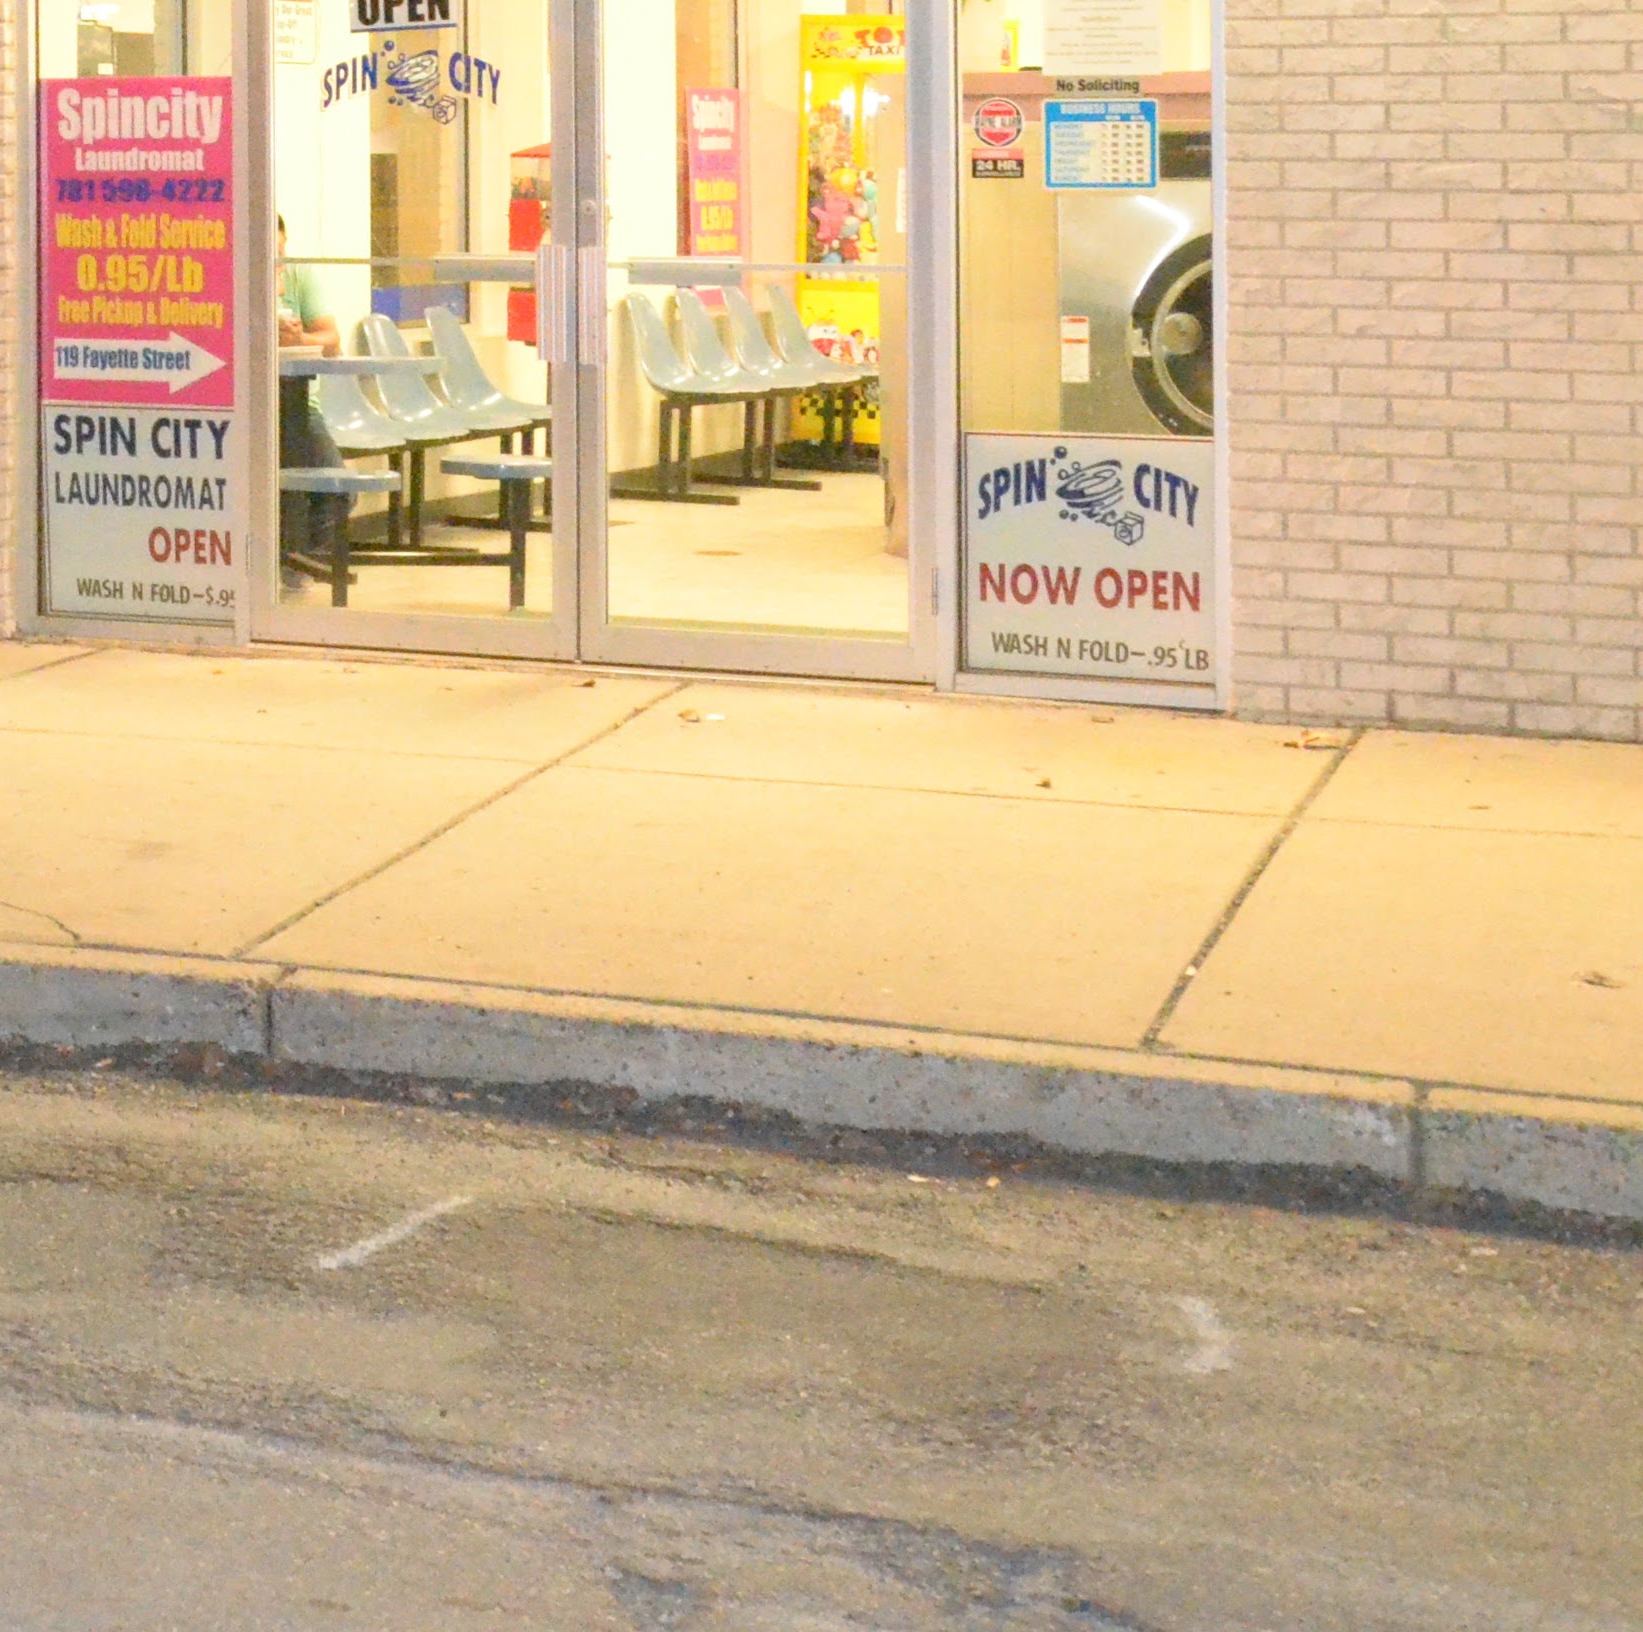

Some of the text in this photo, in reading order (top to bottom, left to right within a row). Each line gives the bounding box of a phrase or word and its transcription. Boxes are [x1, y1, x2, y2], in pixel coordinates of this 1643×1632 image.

[323, 51, 501, 109] SPIN CITY
[1056, 79, 1140, 94] No Soliciting
[57, 88, 223, 144] Spincity
[75, 147, 204, 171] Laundromat
[976, 160, 994, 171] 24
[56, 178, 95, 202] 781
[55, 213, 102, 248] Wash
[121, 213, 157, 248] Fold
[160, 213, 226, 249] Service
[77, 254, 204, 293] 0.95/Lb
[58, 295, 90, 323] Free
[92, 295, 143, 327] Pickup
[160, 297, 223, 329] Delivery
[56, 345, 191, 370] 119 Fayette Street
[53, 414, 231, 459] SPIN CITY
[55, 471, 227, 511] LAUNDROMAT
[978, 458, 1199, 527] SPIN CITY
[148, 526, 232, 566] OPEN
[76, 578, 123, 599] WASH
[132, 582, 143, 601] N
[979, 562, 1200, 612] NOW OPEN
[991, 631, 1048, 657] WASH
[1057, 637, 1071, 659] N
